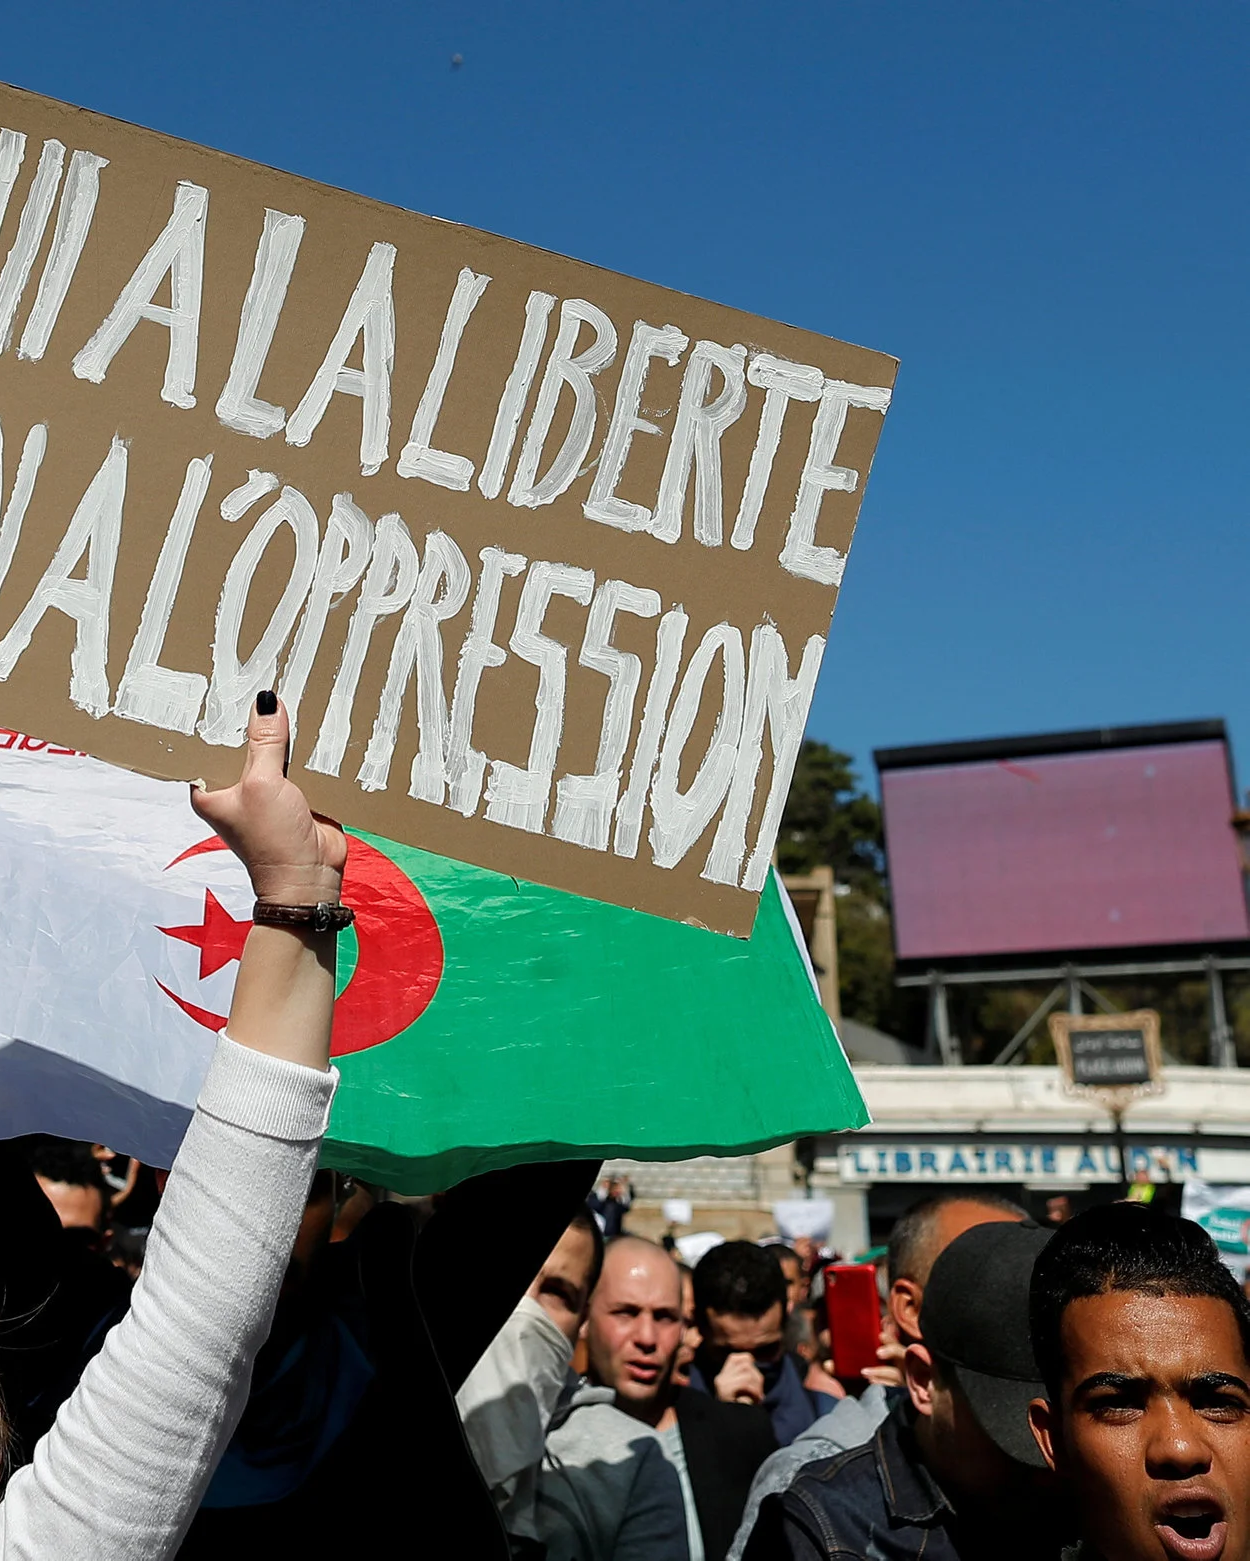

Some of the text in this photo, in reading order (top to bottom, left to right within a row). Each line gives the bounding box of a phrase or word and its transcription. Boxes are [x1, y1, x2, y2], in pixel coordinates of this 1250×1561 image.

[72, 180, 210, 411] A
[215, 208, 399, 477] LA
[397, 266, 893, 587] LIBERTE
[111, 452, 827, 893] L'OPPRESSION
[850, 1147, 1057, 1174] LIBRAIRIE
